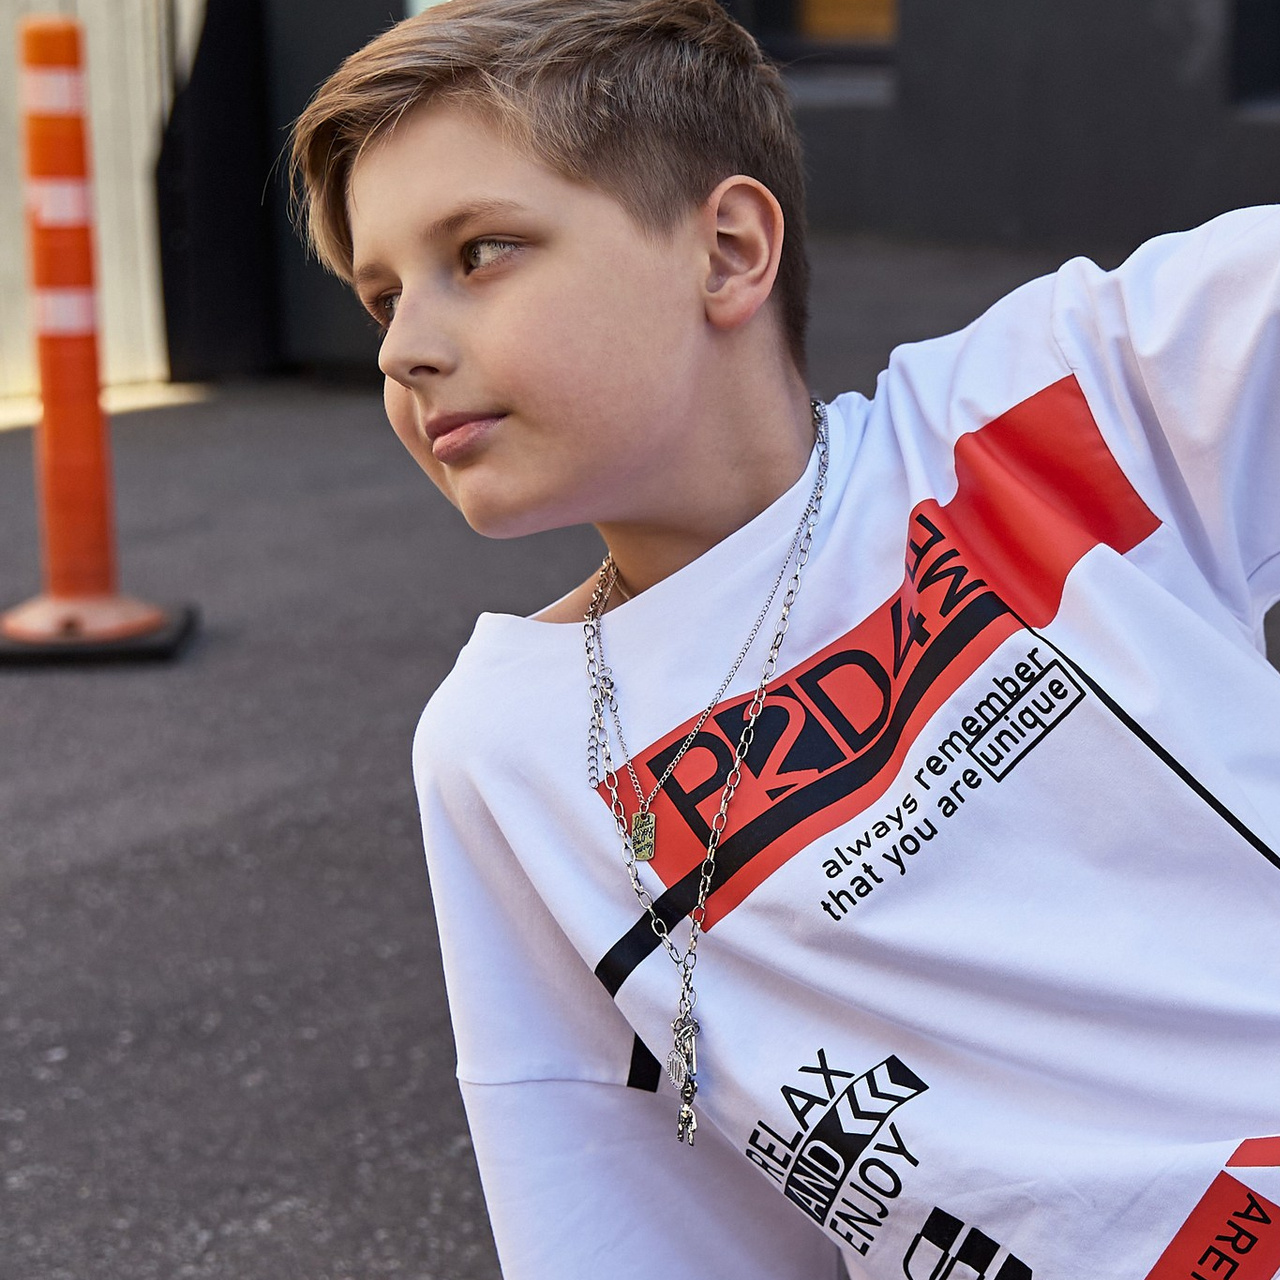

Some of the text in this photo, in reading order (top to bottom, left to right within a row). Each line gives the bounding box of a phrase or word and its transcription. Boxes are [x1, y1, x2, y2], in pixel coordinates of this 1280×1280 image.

[820, 677, 1071, 922] that you are unique
[821, 647, 1045, 880] always remember
[745, 1047, 855, 1184] RELAX
[787, 1138, 846, 1220] AND
[829, 1121, 920, 1257] ENJOY
